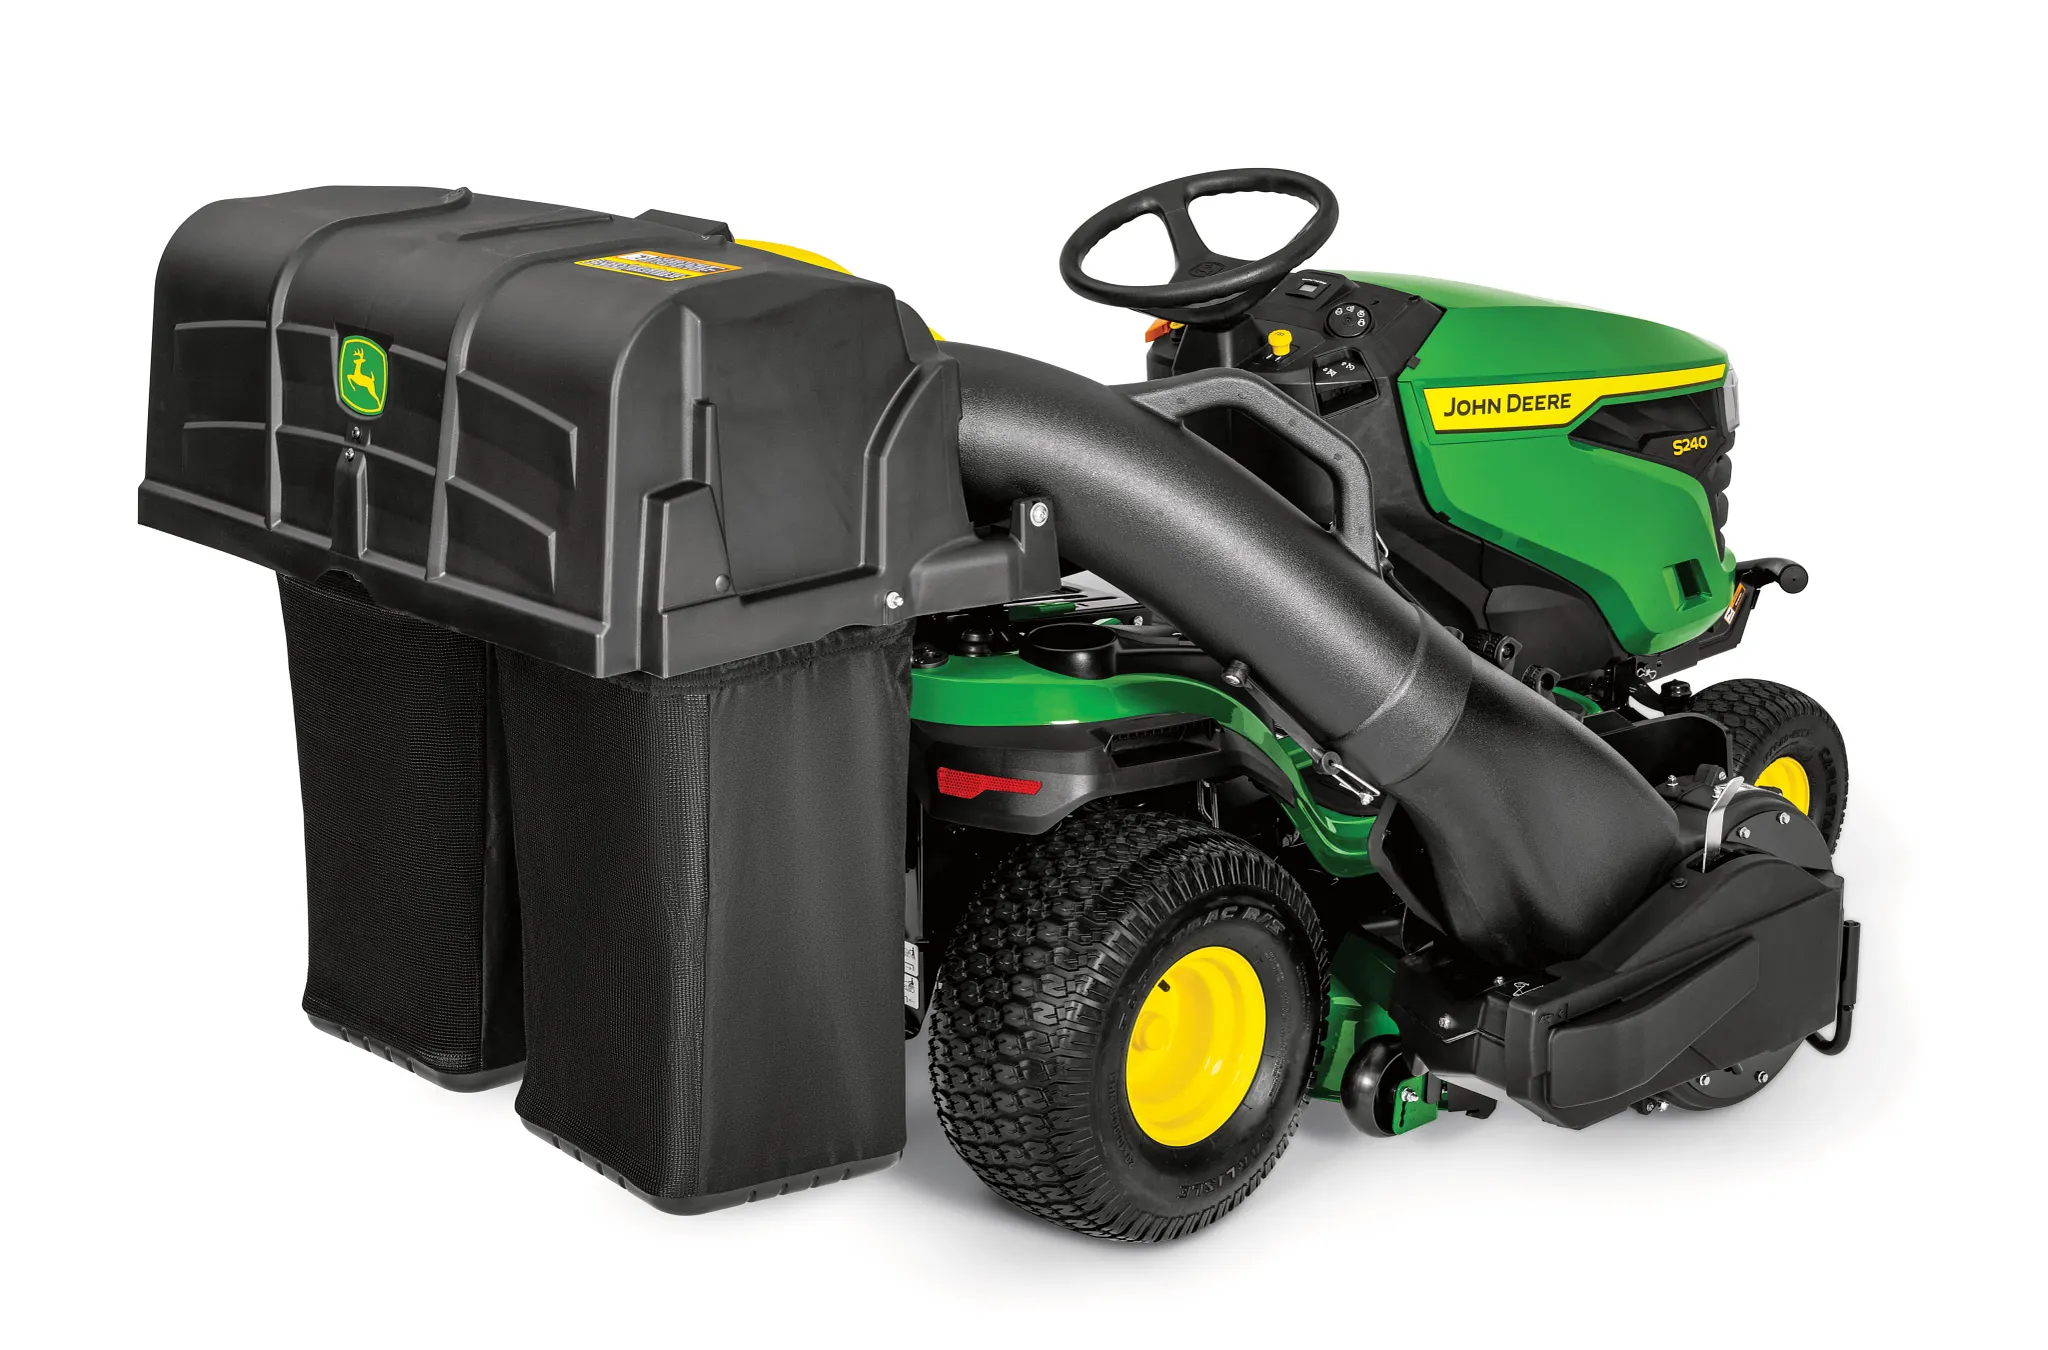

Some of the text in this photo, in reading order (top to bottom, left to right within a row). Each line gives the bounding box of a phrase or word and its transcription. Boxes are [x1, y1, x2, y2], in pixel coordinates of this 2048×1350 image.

[1443, 393, 1572, 417] JOHN DEERE
[1672, 435, 1708, 456] S240
